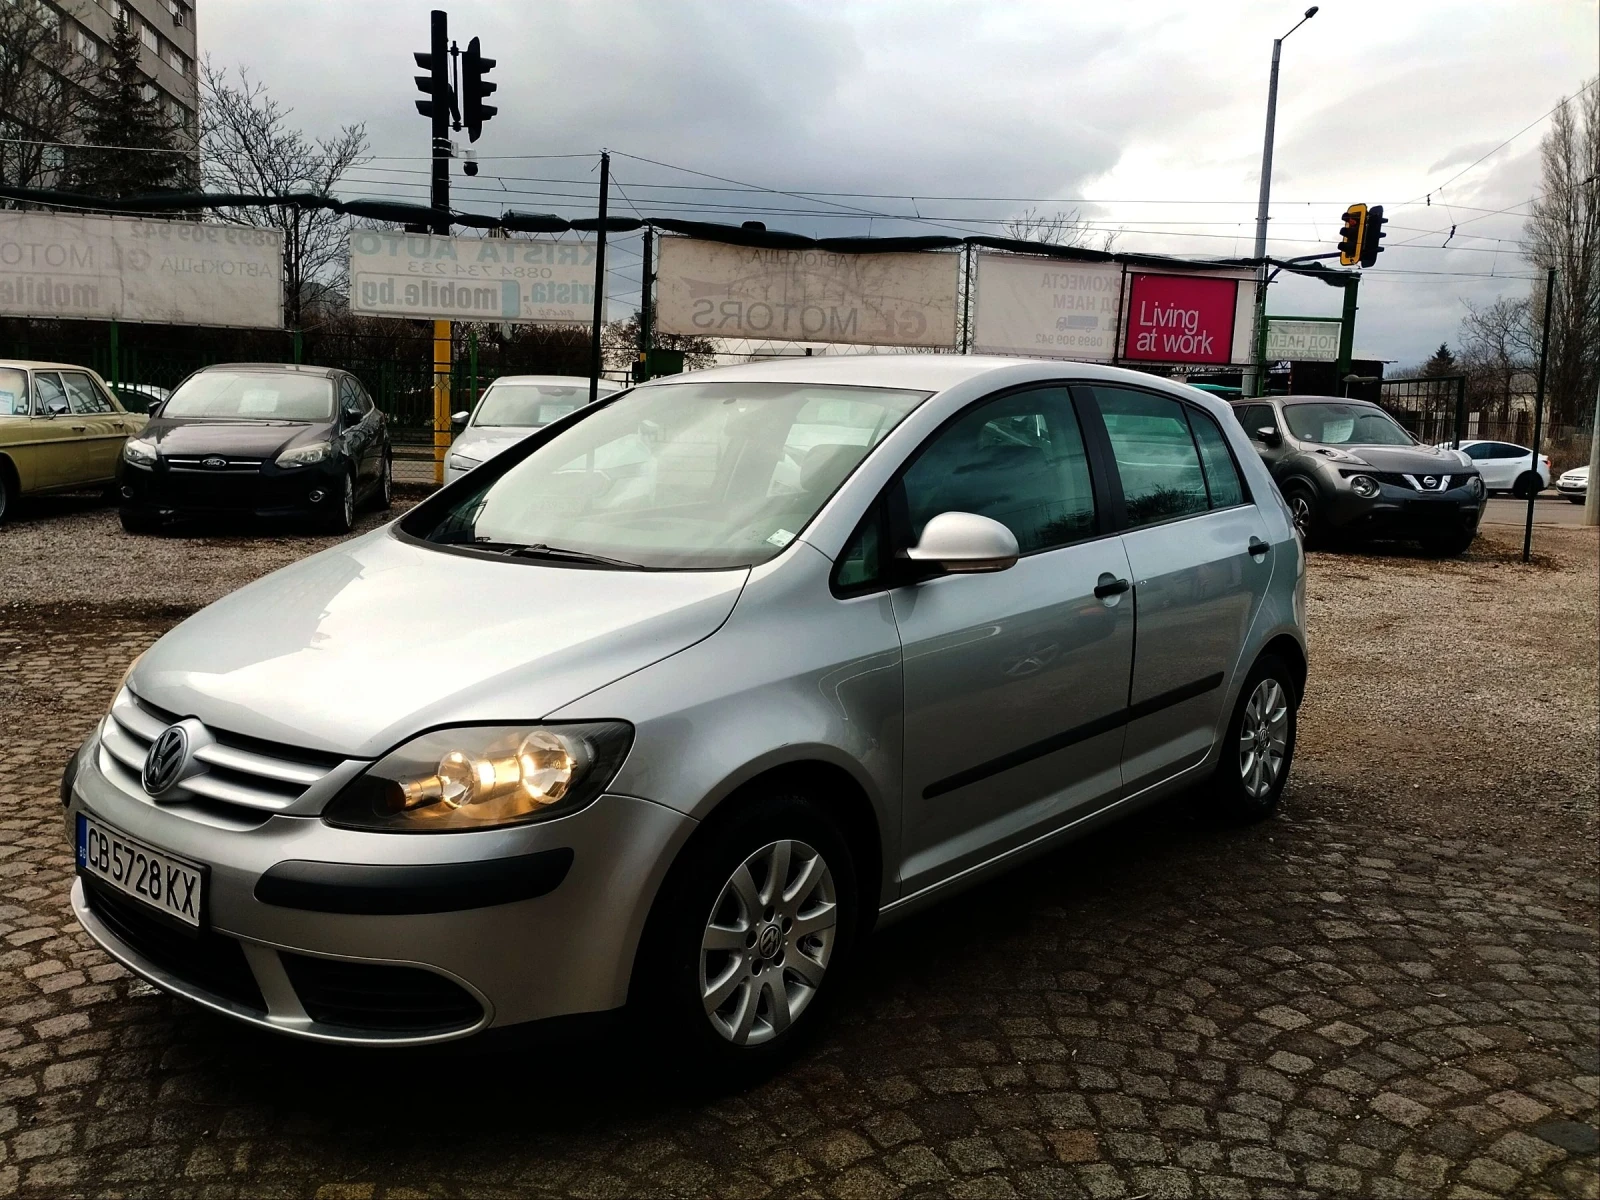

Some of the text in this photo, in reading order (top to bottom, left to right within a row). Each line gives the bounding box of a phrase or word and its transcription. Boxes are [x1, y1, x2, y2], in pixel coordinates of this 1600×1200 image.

[1139, 300, 1199, 335] Living
[1136, 328, 1158, 352] at
[1163, 330, 1214, 355] work
